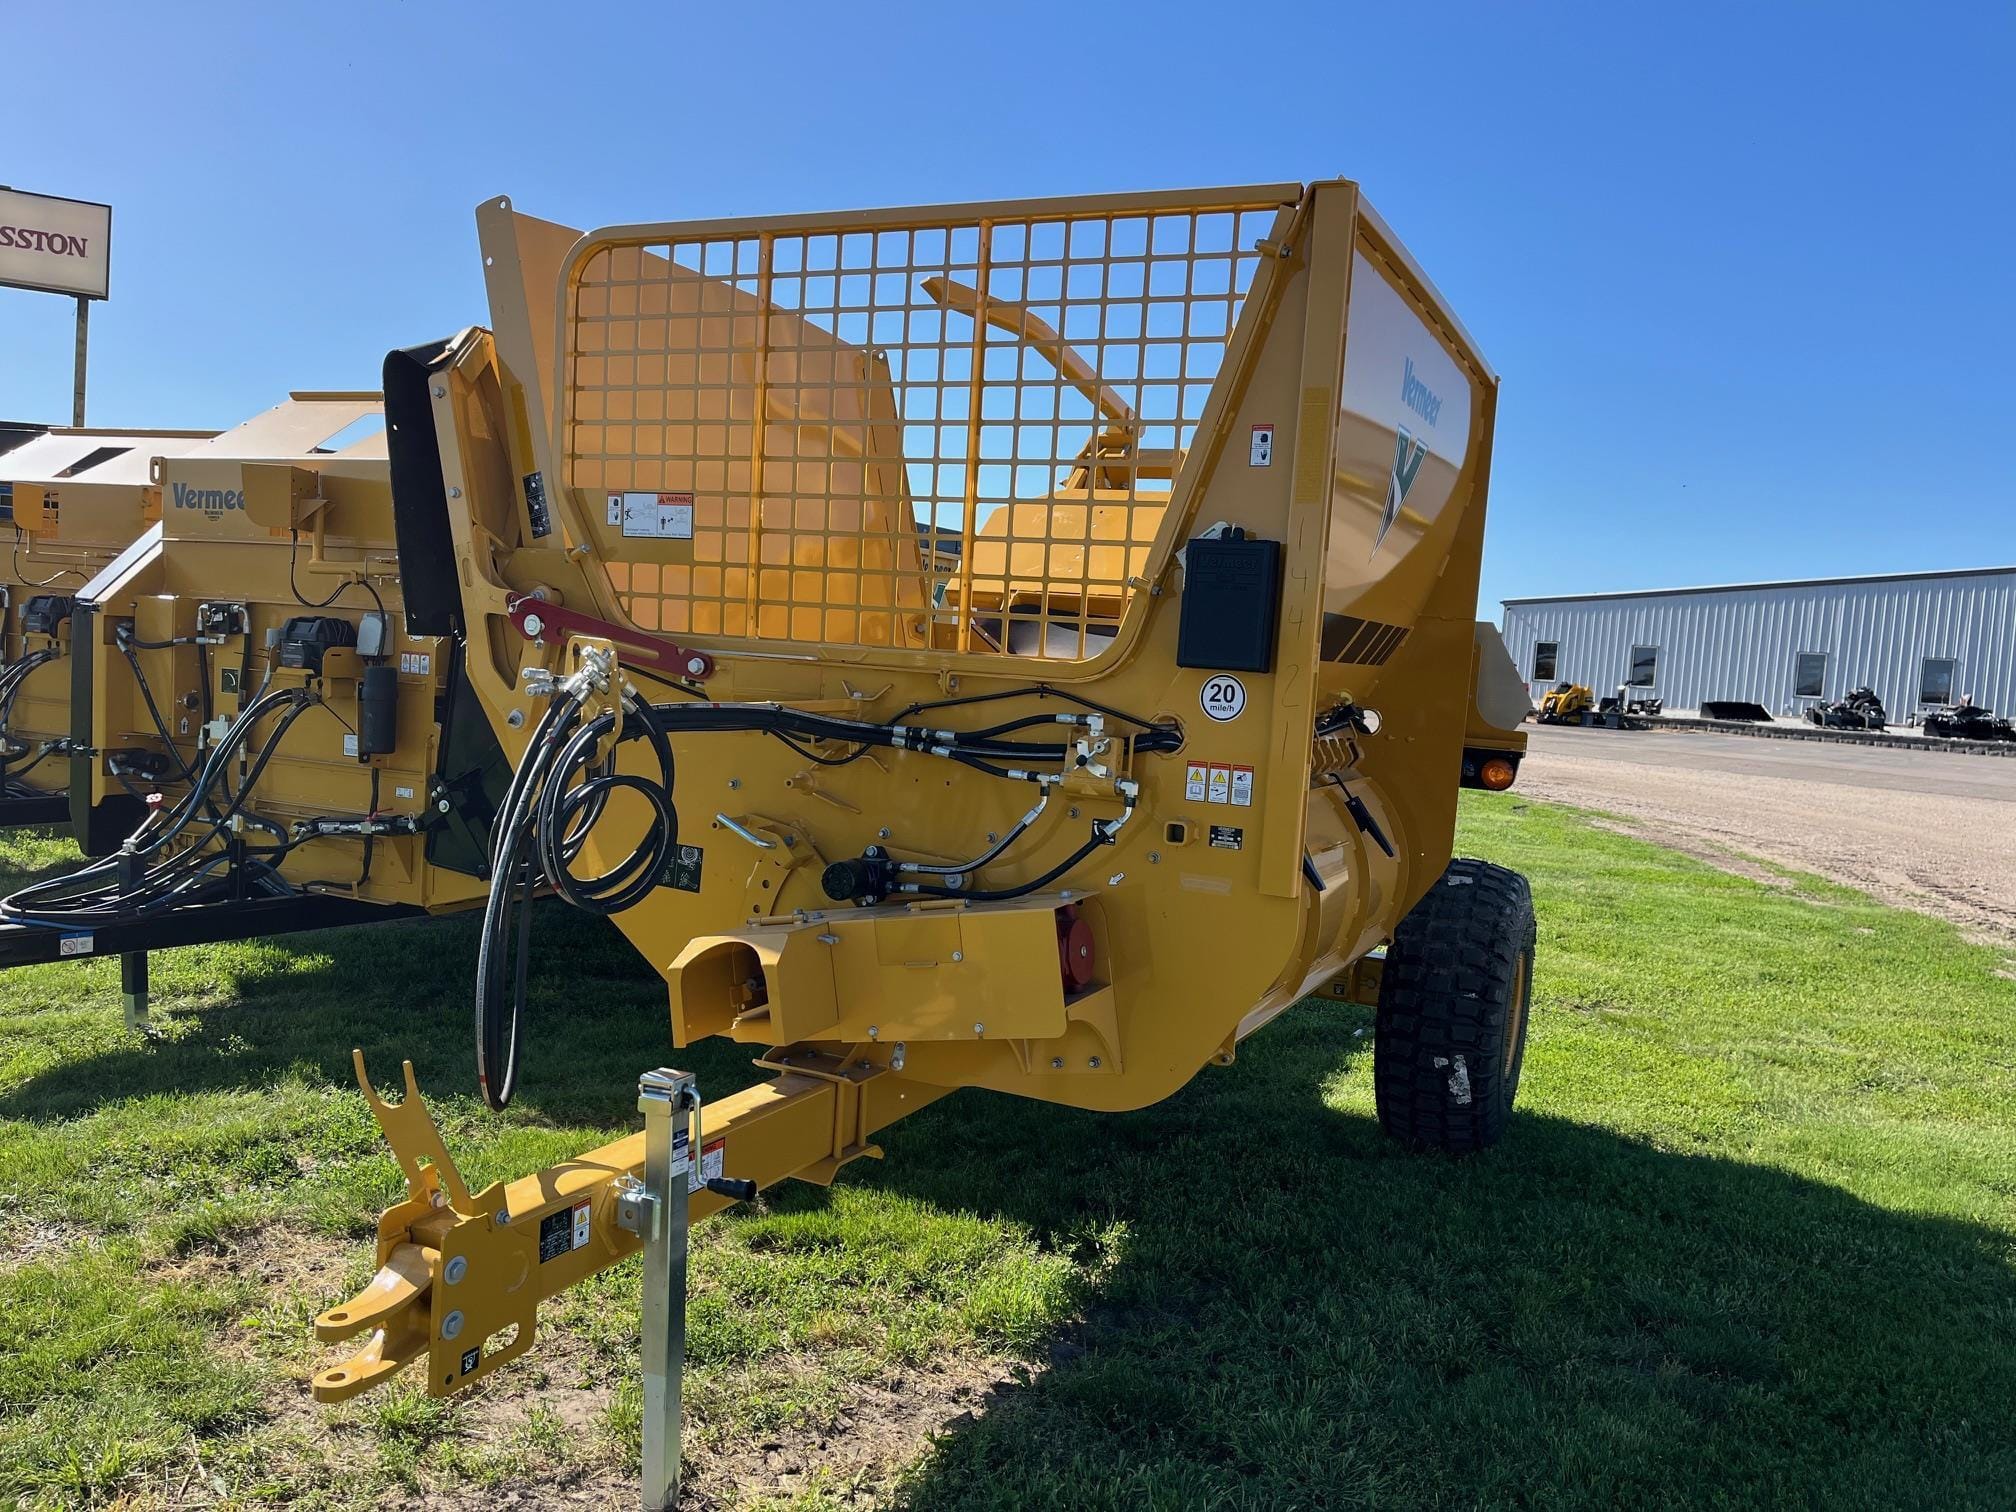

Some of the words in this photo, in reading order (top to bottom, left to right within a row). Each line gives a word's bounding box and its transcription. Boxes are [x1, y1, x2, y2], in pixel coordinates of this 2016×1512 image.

[0, 225, 88, 258] SSTON
[1401, 356, 1443, 428] Vermeer
[665, 495, 692, 504] WARNING
[1209, 683, 1235, 703] 20
[1209, 703, 1235, 712] mile/h
